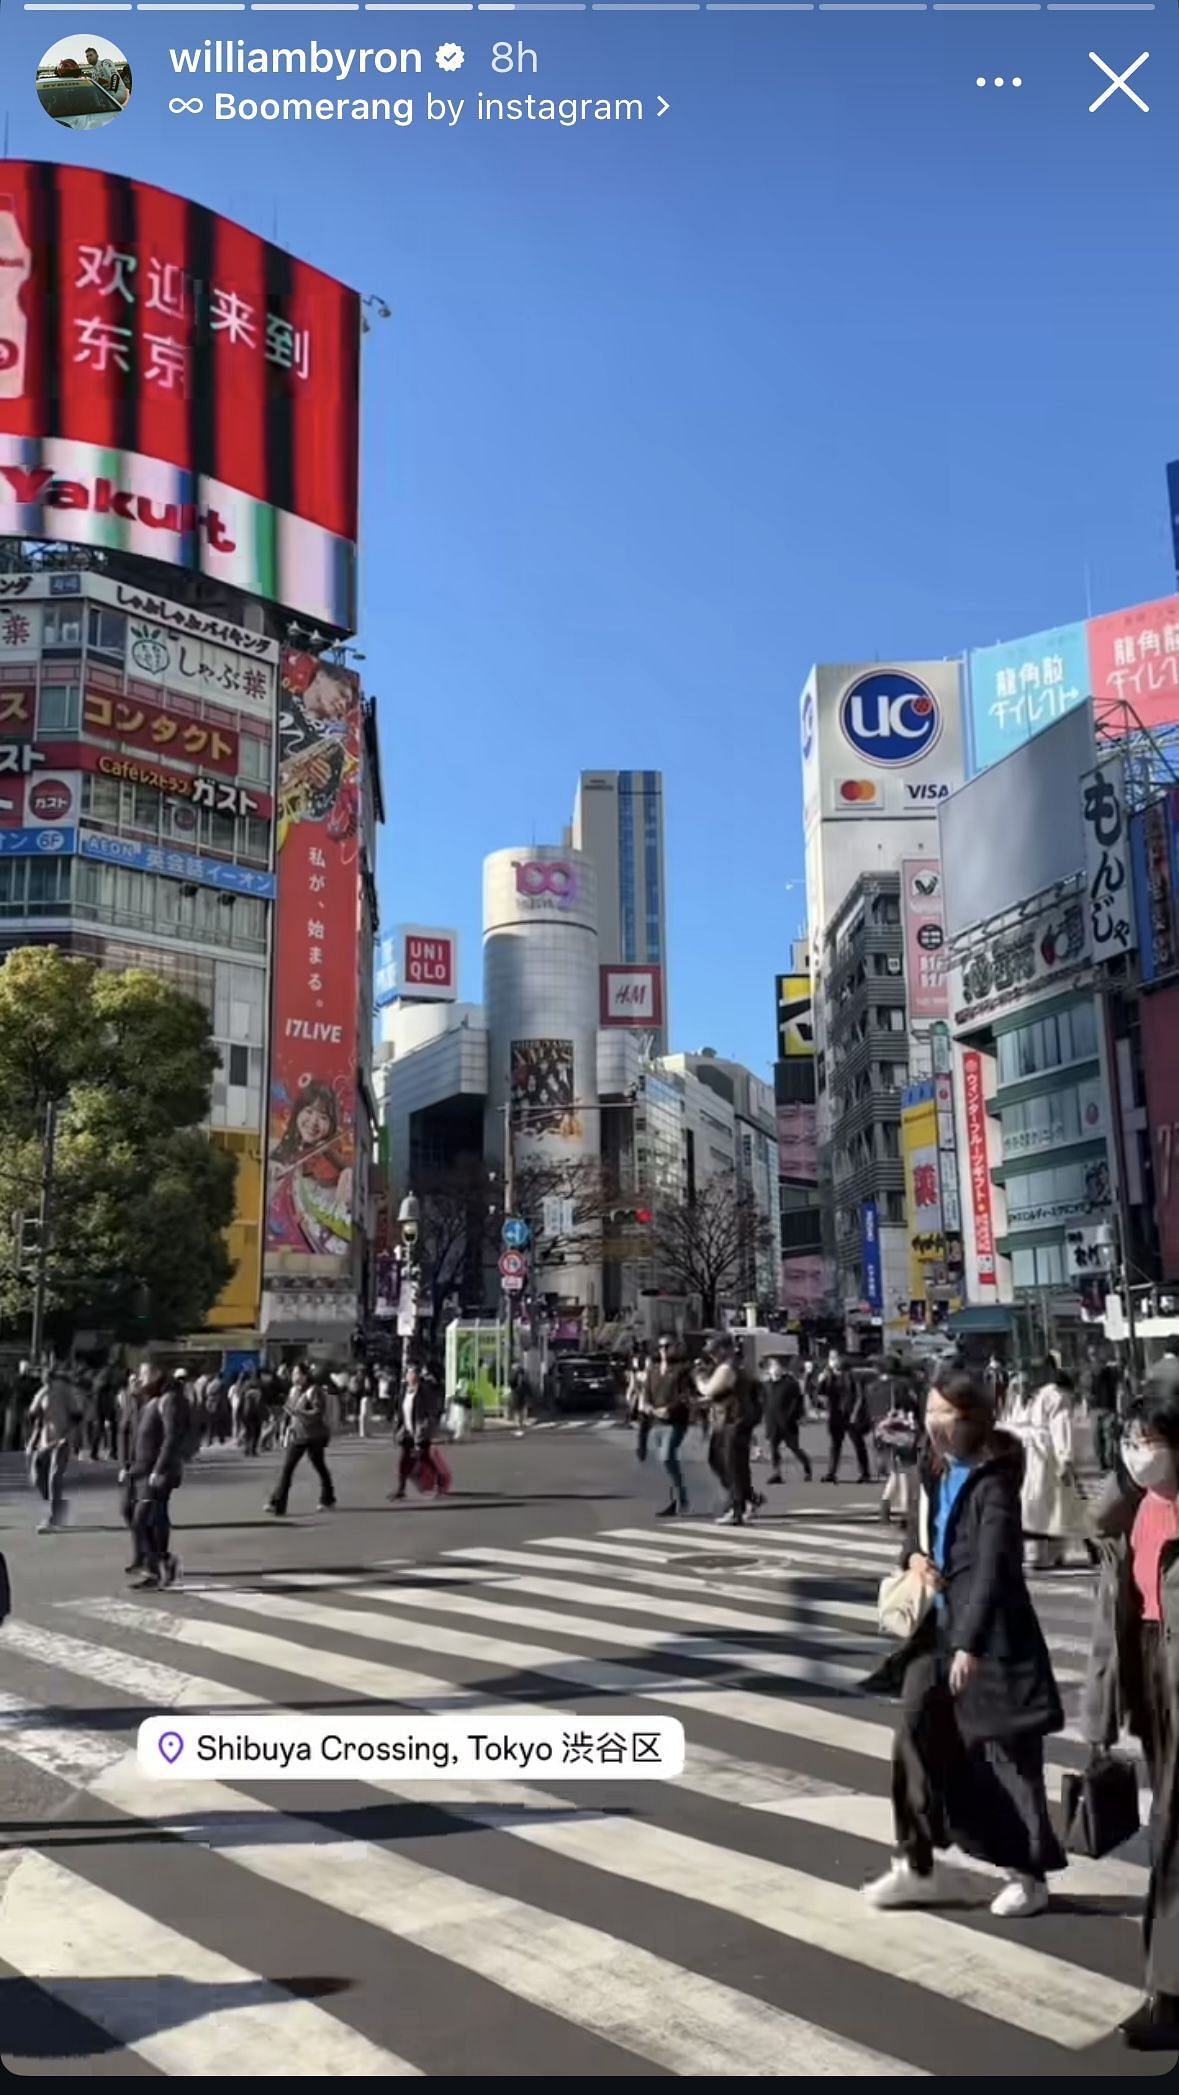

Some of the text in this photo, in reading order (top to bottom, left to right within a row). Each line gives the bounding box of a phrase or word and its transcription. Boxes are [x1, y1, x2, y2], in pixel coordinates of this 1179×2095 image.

[74, 245, 309, 380] 欢迎来到
[73, 316, 187, 389] 东京
[0, 465, 236, 553] Yakult
[179, 646, 267, 700] しゃぶ葉
[84, 693, 233, 760] コンタクト
[35, 796, 68, 809] ガスト
[191, 777, 258, 815] ガスト
[907, 783, 950, 799] VISA
[146, 850, 272, 891] 英会話イーオン
[1084, 771, 1131, 947] もんじゃ
[511, 861, 577, 905] 109
[307, 847, 326, 1008] 私が、始まる。
[410, 941, 443, 961] UNI
[410, 960, 446, 981] QLO
[615, 984, 647, 1004] H&M
